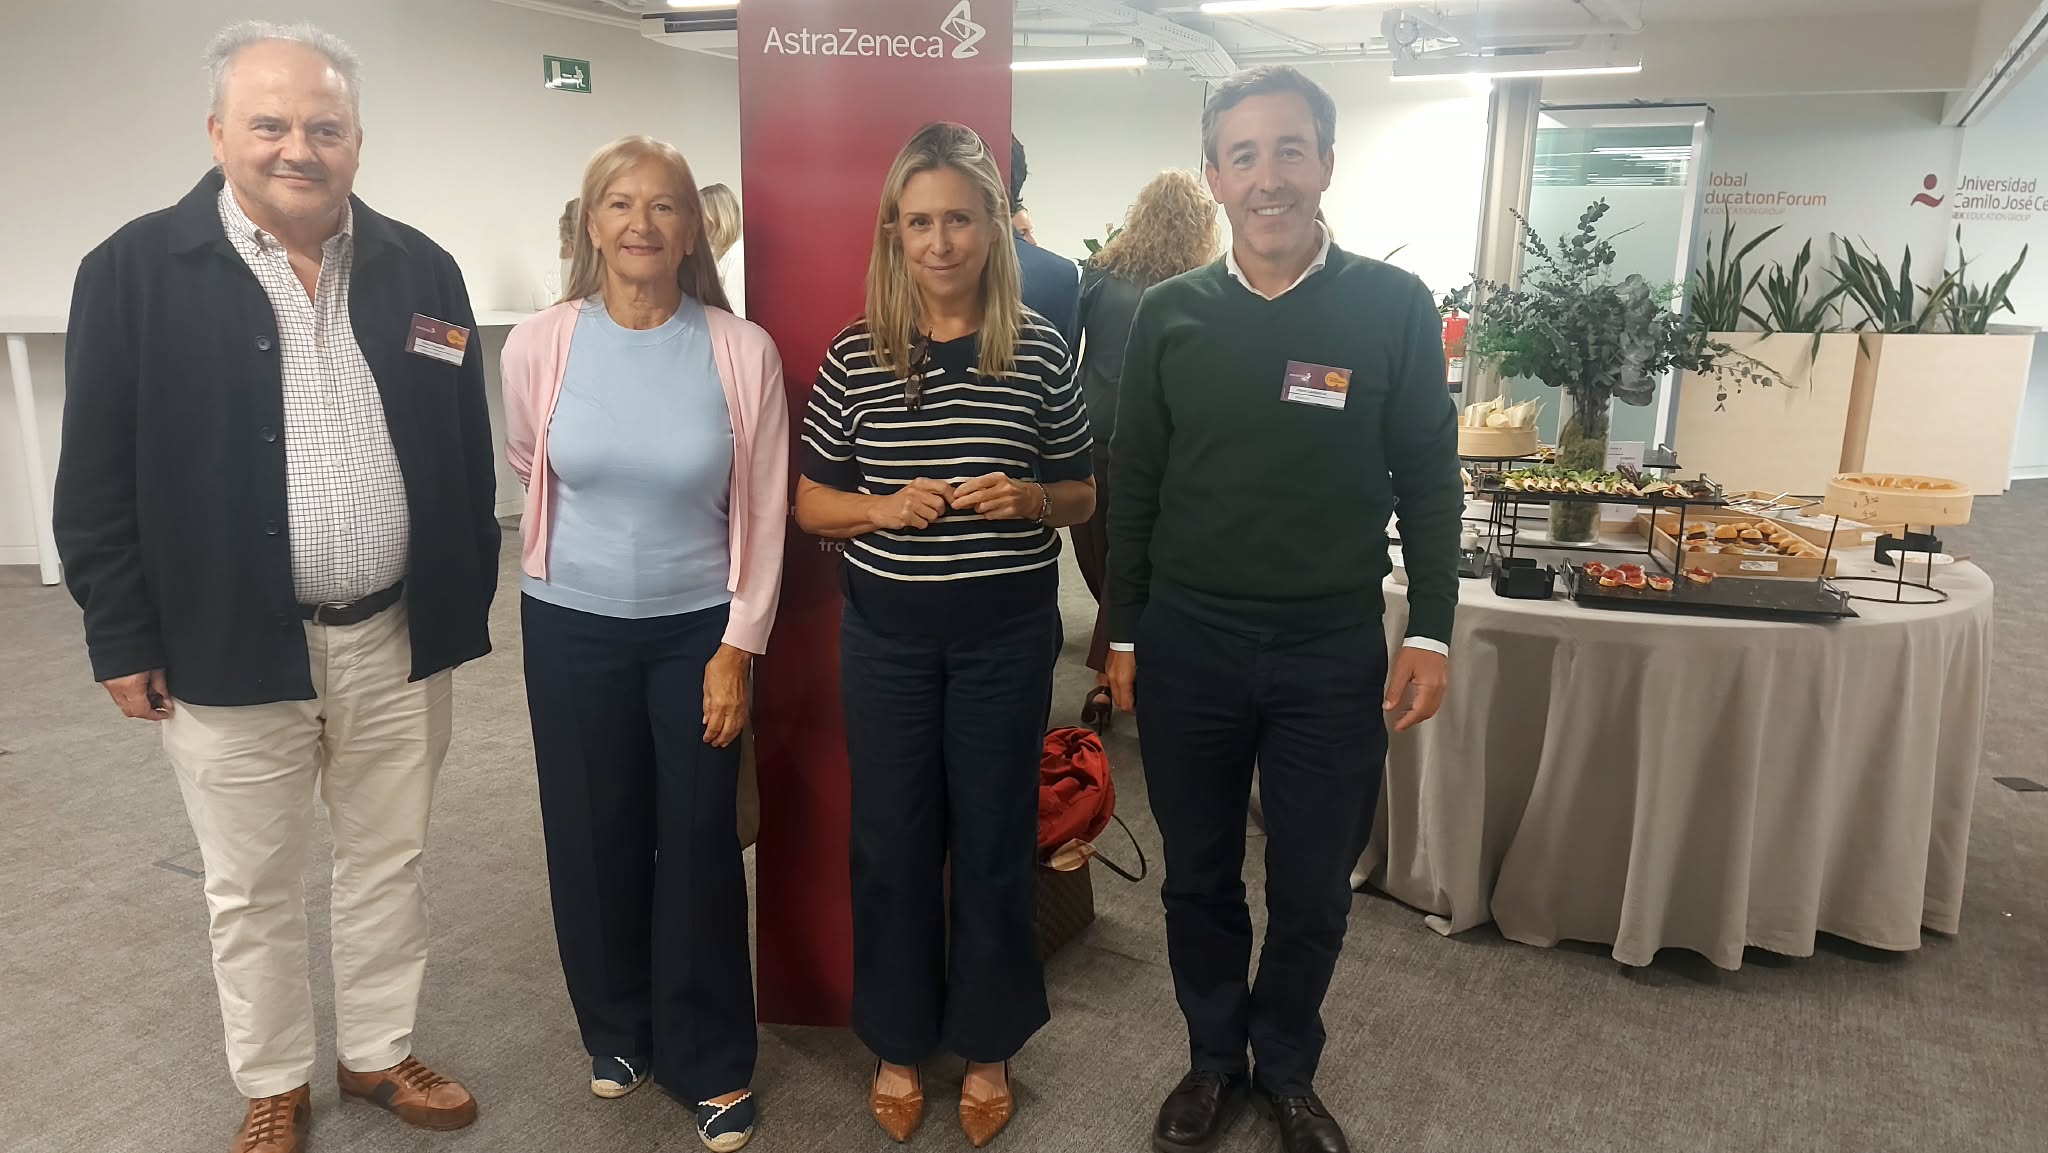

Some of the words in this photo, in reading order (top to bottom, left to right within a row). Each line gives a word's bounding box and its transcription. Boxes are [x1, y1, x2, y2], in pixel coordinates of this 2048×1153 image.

[763, 26, 944, 58] AstraZeneca
[1709, 171, 1747, 187] lobal
[1705, 189, 1827, 206] ducationForum
[2001, 195, 2033, 210] José
[2034, 196, 2048, 211] Ce
